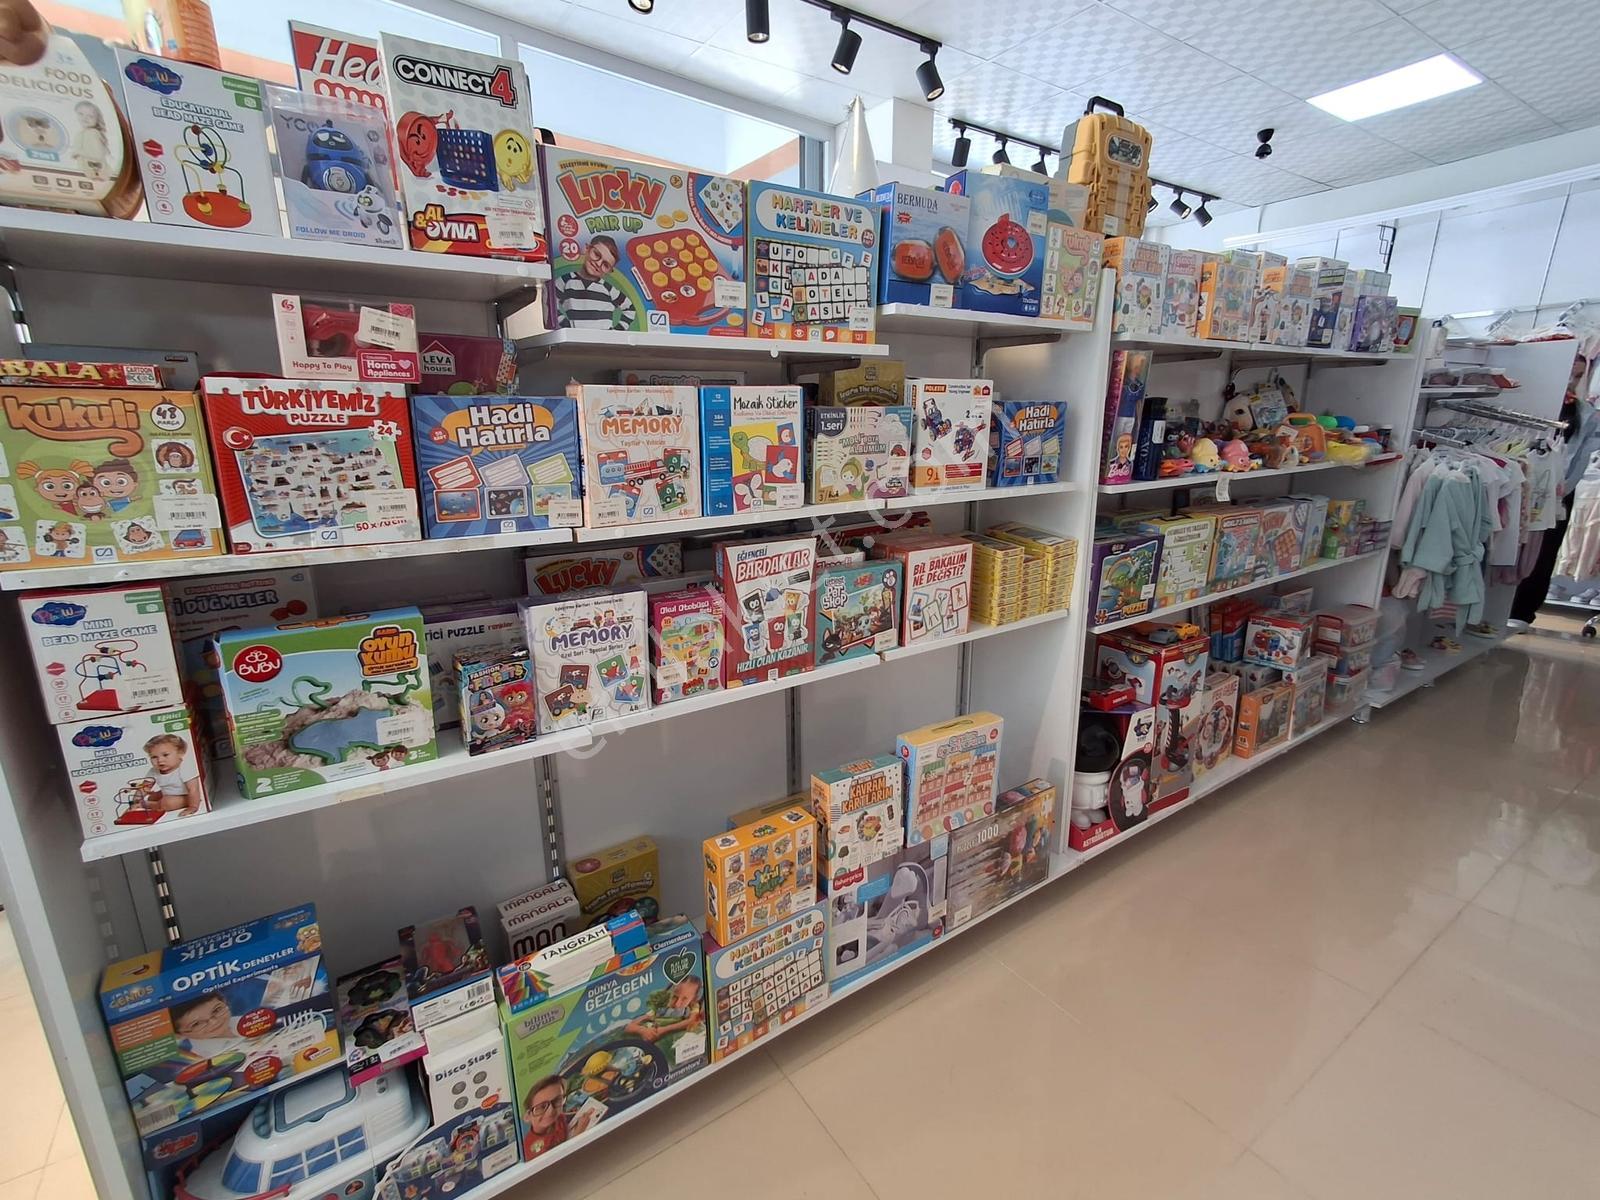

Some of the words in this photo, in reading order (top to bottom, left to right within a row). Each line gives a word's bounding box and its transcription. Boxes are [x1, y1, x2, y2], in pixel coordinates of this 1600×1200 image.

[44, 67, 92, 85] FOOD
[398, 59, 492, 96] CONNECT
[490, 70, 515, 106] 4
[161, 97, 232, 120] EDUCATIONAL
[152, 106, 182, 121] BEAD
[183, 113, 213, 127] MAZE
[214, 119, 244, 133] GAME
[557, 168, 666, 219] LUCKY
[897, 192, 938, 211] BERMUDA
[425, 205, 445, 222] AL
[771, 193, 841, 220] HARFLER
[844, 206, 863, 224] VE
[295, 225, 328, 236] FOLLOW
[426, 220, 478, 241] OYNA
[585, 215, 621, 235] PAIR
[622, 216, 643, 234] UP
[775, 212, 858, 240] KELİMELER
[562, 243, 579, 254] 20
[292, 360, 321, 372] Happy
[322, 361, 333, 370] To
[334, 362, 353, 373] Play
[366, 359, 397, 370] Home
[422, 355, 452, 364] LEVA
[423, 364, 453, 373] house
[367, 369, 411, 378] Appliances
[242, 385, 376, 413] TÜRKİYEMİZ
[733, 394, 764, 410] Mozaik
[766, 394, 798, 410] Sticker
[3, 396, 141, 431] kukuli
[156, 406, 178, 420] 48
[290, 413, 346, 424] PUZZLE
[468, 402, 535, 427] Hadi
[1025, 404, 1051, 419] Hadi
[377, 424, 394, 436] 24
[601, 416, 683, 436] MEMORY
[1018, 417, 1056, 432] Hatırla
[456, 425, 551, 448] Hatırla
[355, 522, 369, 532] 50
[736, 545, 769, 562] EĞLENCELİ
[735, 550, 811, 583] BARDAKLAR
[913, 562, 927, 577] BİL
[929, 552, 968, 574] BAKALIM
[535, 557, 621, 595] LUCKY
[913, 575, 925, 588] NE
[184, 589, 279, 614] DÜĞMELER
[83, 618, 114, 631] MINI
[447, 624, 485, 639] PUZZLE
[42, 633, 78, 647] BEAD
[81, 629, 119, 643] MAZE
[121, 624, 158, 638] GAME
[551, 623, 633, 651] MEMORY
[238, 659, 281, 676] BUBU
[736, 659, 757, 673] HIZLI
[757, 652, 778, 668] OLAN
[778, 643, 809, 663] KAZANIR
[468, 665, 501, 680] FASHION
[255, 777, 273, 793] 2
[850, 776, 887, 800] KAVRAM
[977, 824, 999, 845] 1000
[503, 881, 568, 912] MANGALA
[507, 895, 574, 928] MANGALA
[541, 927, 606, 961] TANGRAM
[653, 931, 692, 951] Clementoni
[729, 924, 793, 962] HARFLER
[796, 913, 813, 929] VE
[734, 927, 809, 971] KELİMELER
[172, 958, 242, 992] OPTİK
[242, 947, 294, 970] DENEYLER
[201, 980, 232, 994] Optical
[232, 965, 279, 984] Experiments
[584, 971, 653, 1013] GEZEGENİ
[587, 979, 618, 997] DÜNYA
[435, 1063, 467, 1082] Disco
[467, 1047, 499, 1067] Stage
